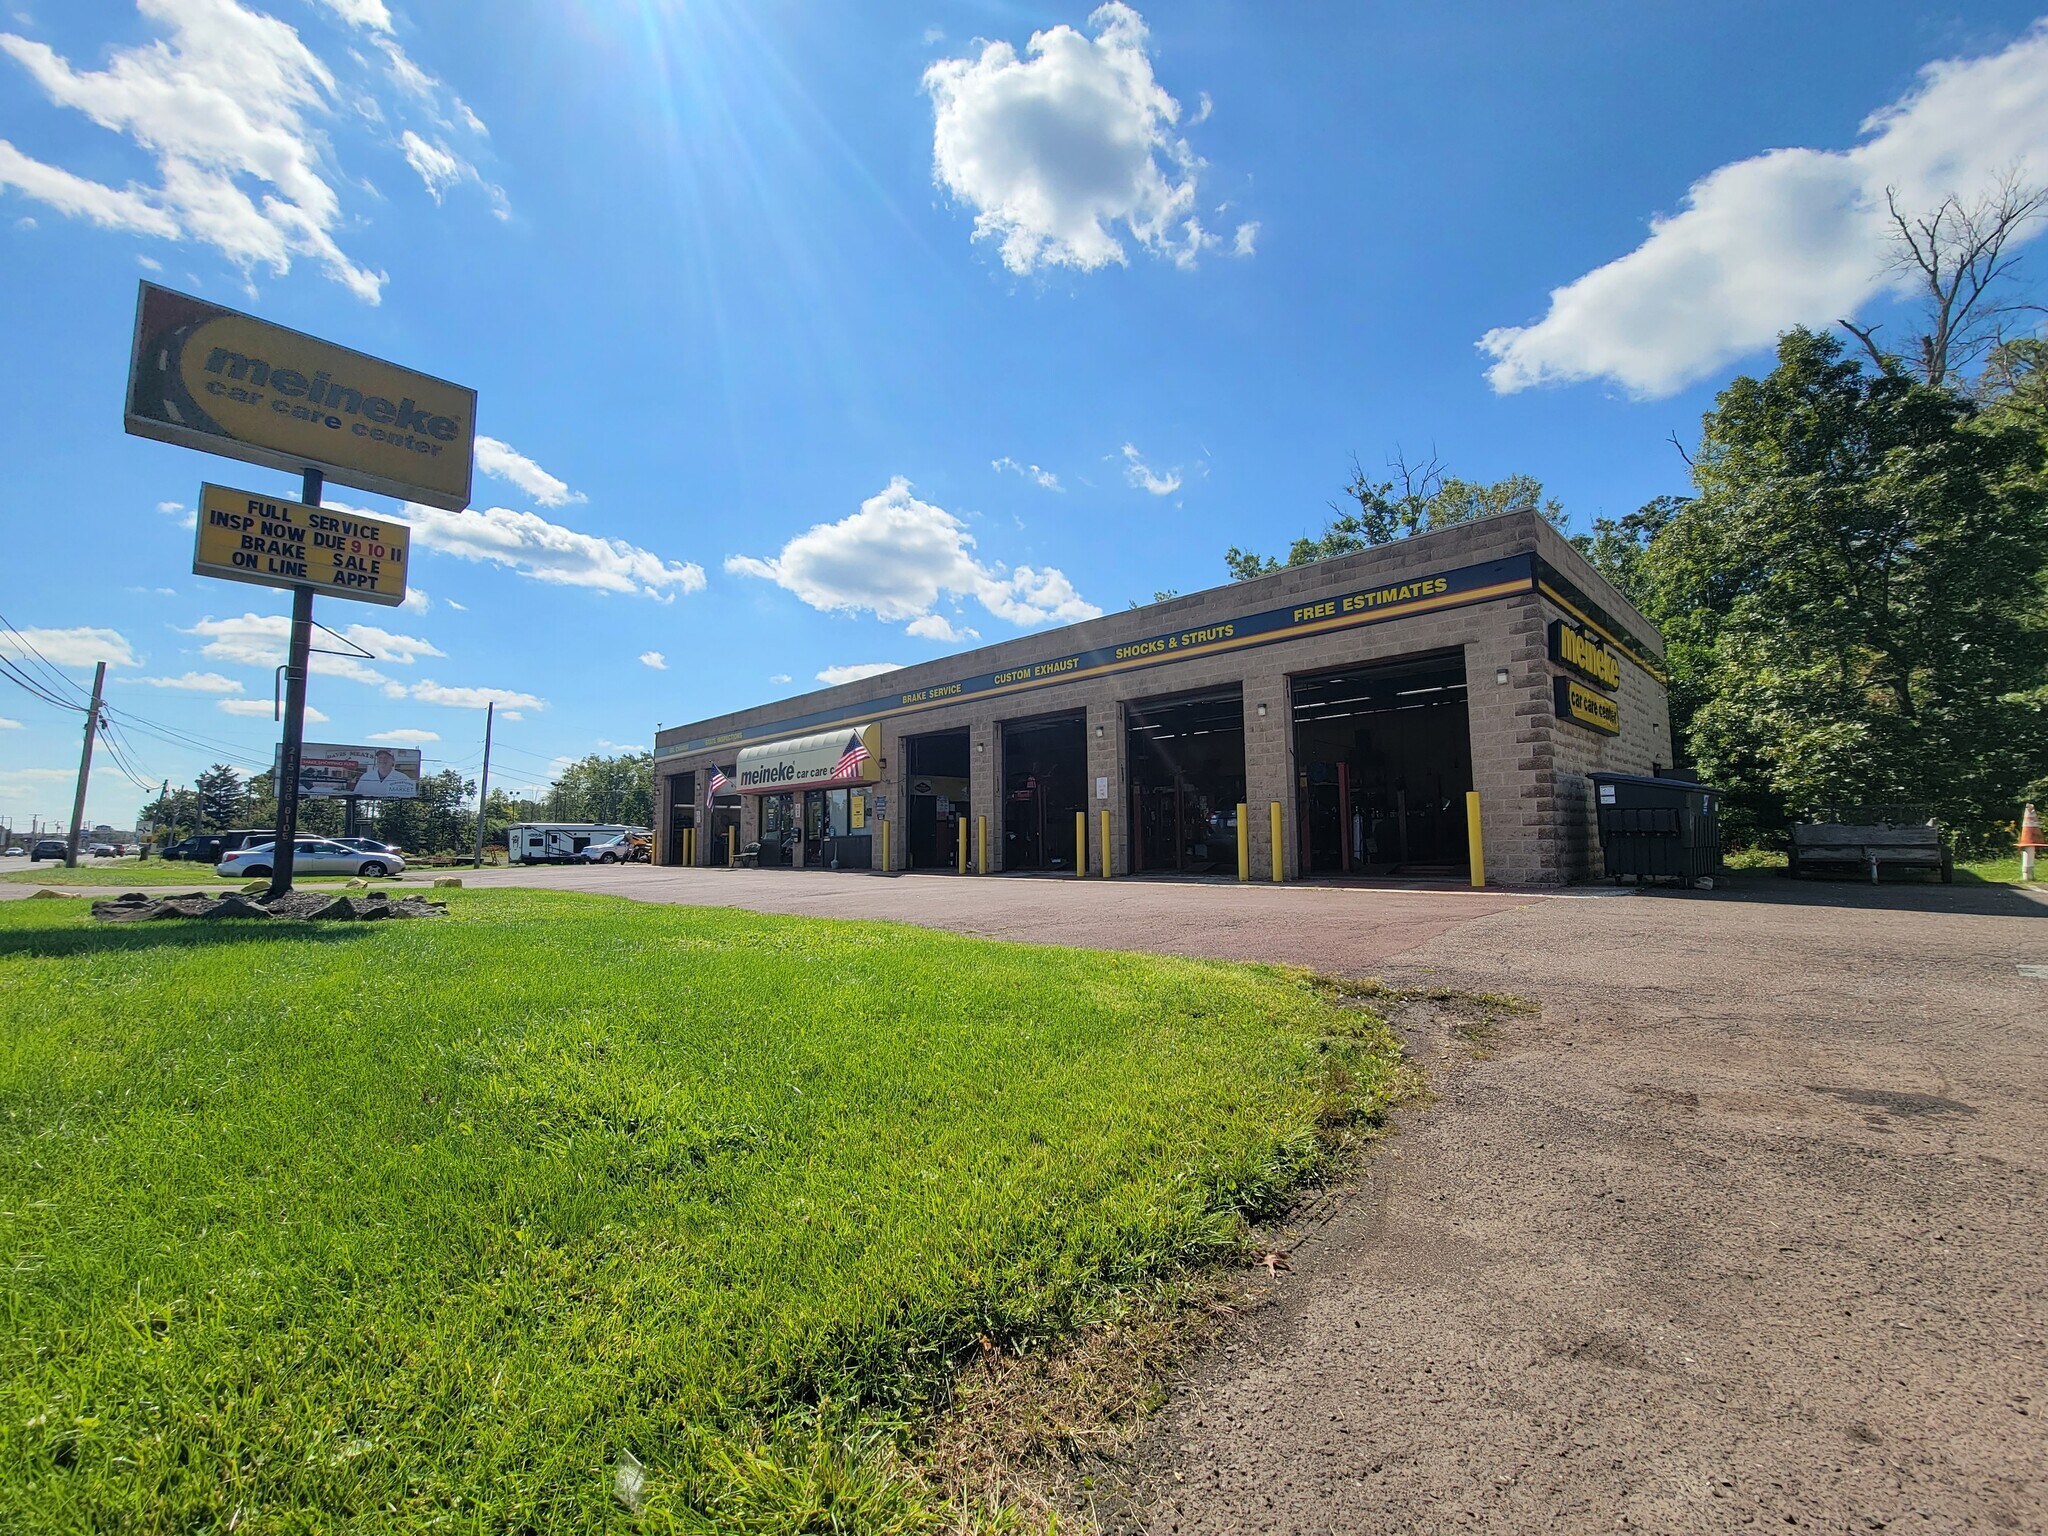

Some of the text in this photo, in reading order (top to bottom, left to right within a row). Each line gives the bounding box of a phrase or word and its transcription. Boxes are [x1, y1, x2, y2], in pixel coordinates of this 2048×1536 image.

[204, 347, 459, 441] meineke
[207, 380, 443, 456] car care center
[210, 510, 254, 532] INSP
[261, 521, 305, 542] NOW
[313, 532, 346, 551] DUE
[351, 540, 361, 554] 9
[368, 543, 385, 558] 10
[248, 500, 379, 541] FULL SERVICE
[232, 551, 379, 590] ON LINE APPT
[241, 535, 380, 574] BRAKE SALE
[1293, 578, 1447, 622] FREE ESTIMATES
[1115, 625, 1234, 660] SHOCKS & STRUTS
[1561, 624, 1619, 688] meineke
[994, 658, 1079, 685] CUSTOM EXHAUST
[902, 684, 962, 704] BRAKE SERVICE
[1571, 691, 1582, 707] car
[1584, 698, 1598, 715] care
[287, 746, 296, 771] 215
[741, 762, 795, 786] meineke
[796, 770, 809, 779] car
[810, 767, 828, 777] care
